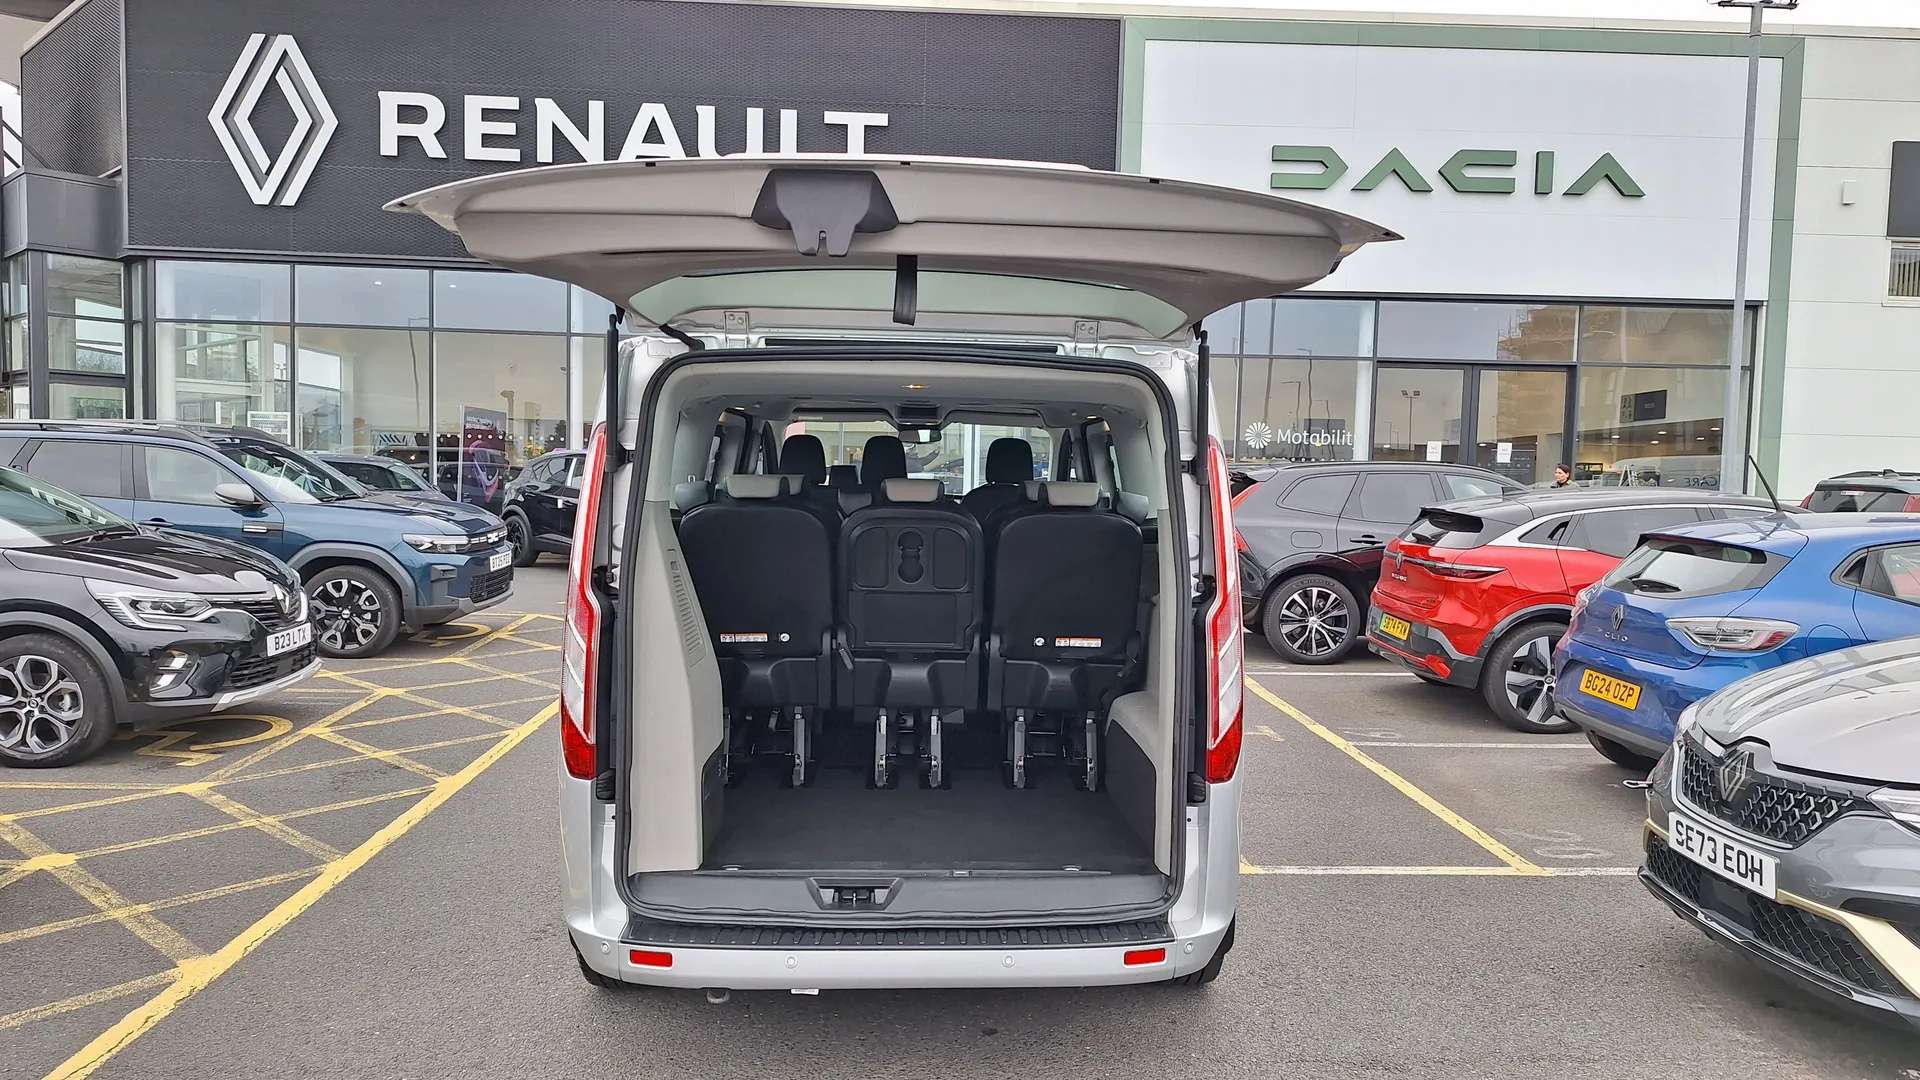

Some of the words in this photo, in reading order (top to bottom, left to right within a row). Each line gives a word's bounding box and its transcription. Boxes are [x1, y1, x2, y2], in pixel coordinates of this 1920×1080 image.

[378, 91, 889, 164] RENAULT
[1270, 144, 1646, 199] DACIA
[1276, 428, 1356, 450] Motabilit
[275, 632, 291, 651] B23
[292, 627, 307, 645] LTX
[1604, 631, 1628, 642] CLIO
[1585, 673, 1612, 696] BG24
[1612, 683, 1635, 704] OZP
[1676, 819, 1717, 865] SE73
[1723, 843, 1763, 887] EOH
